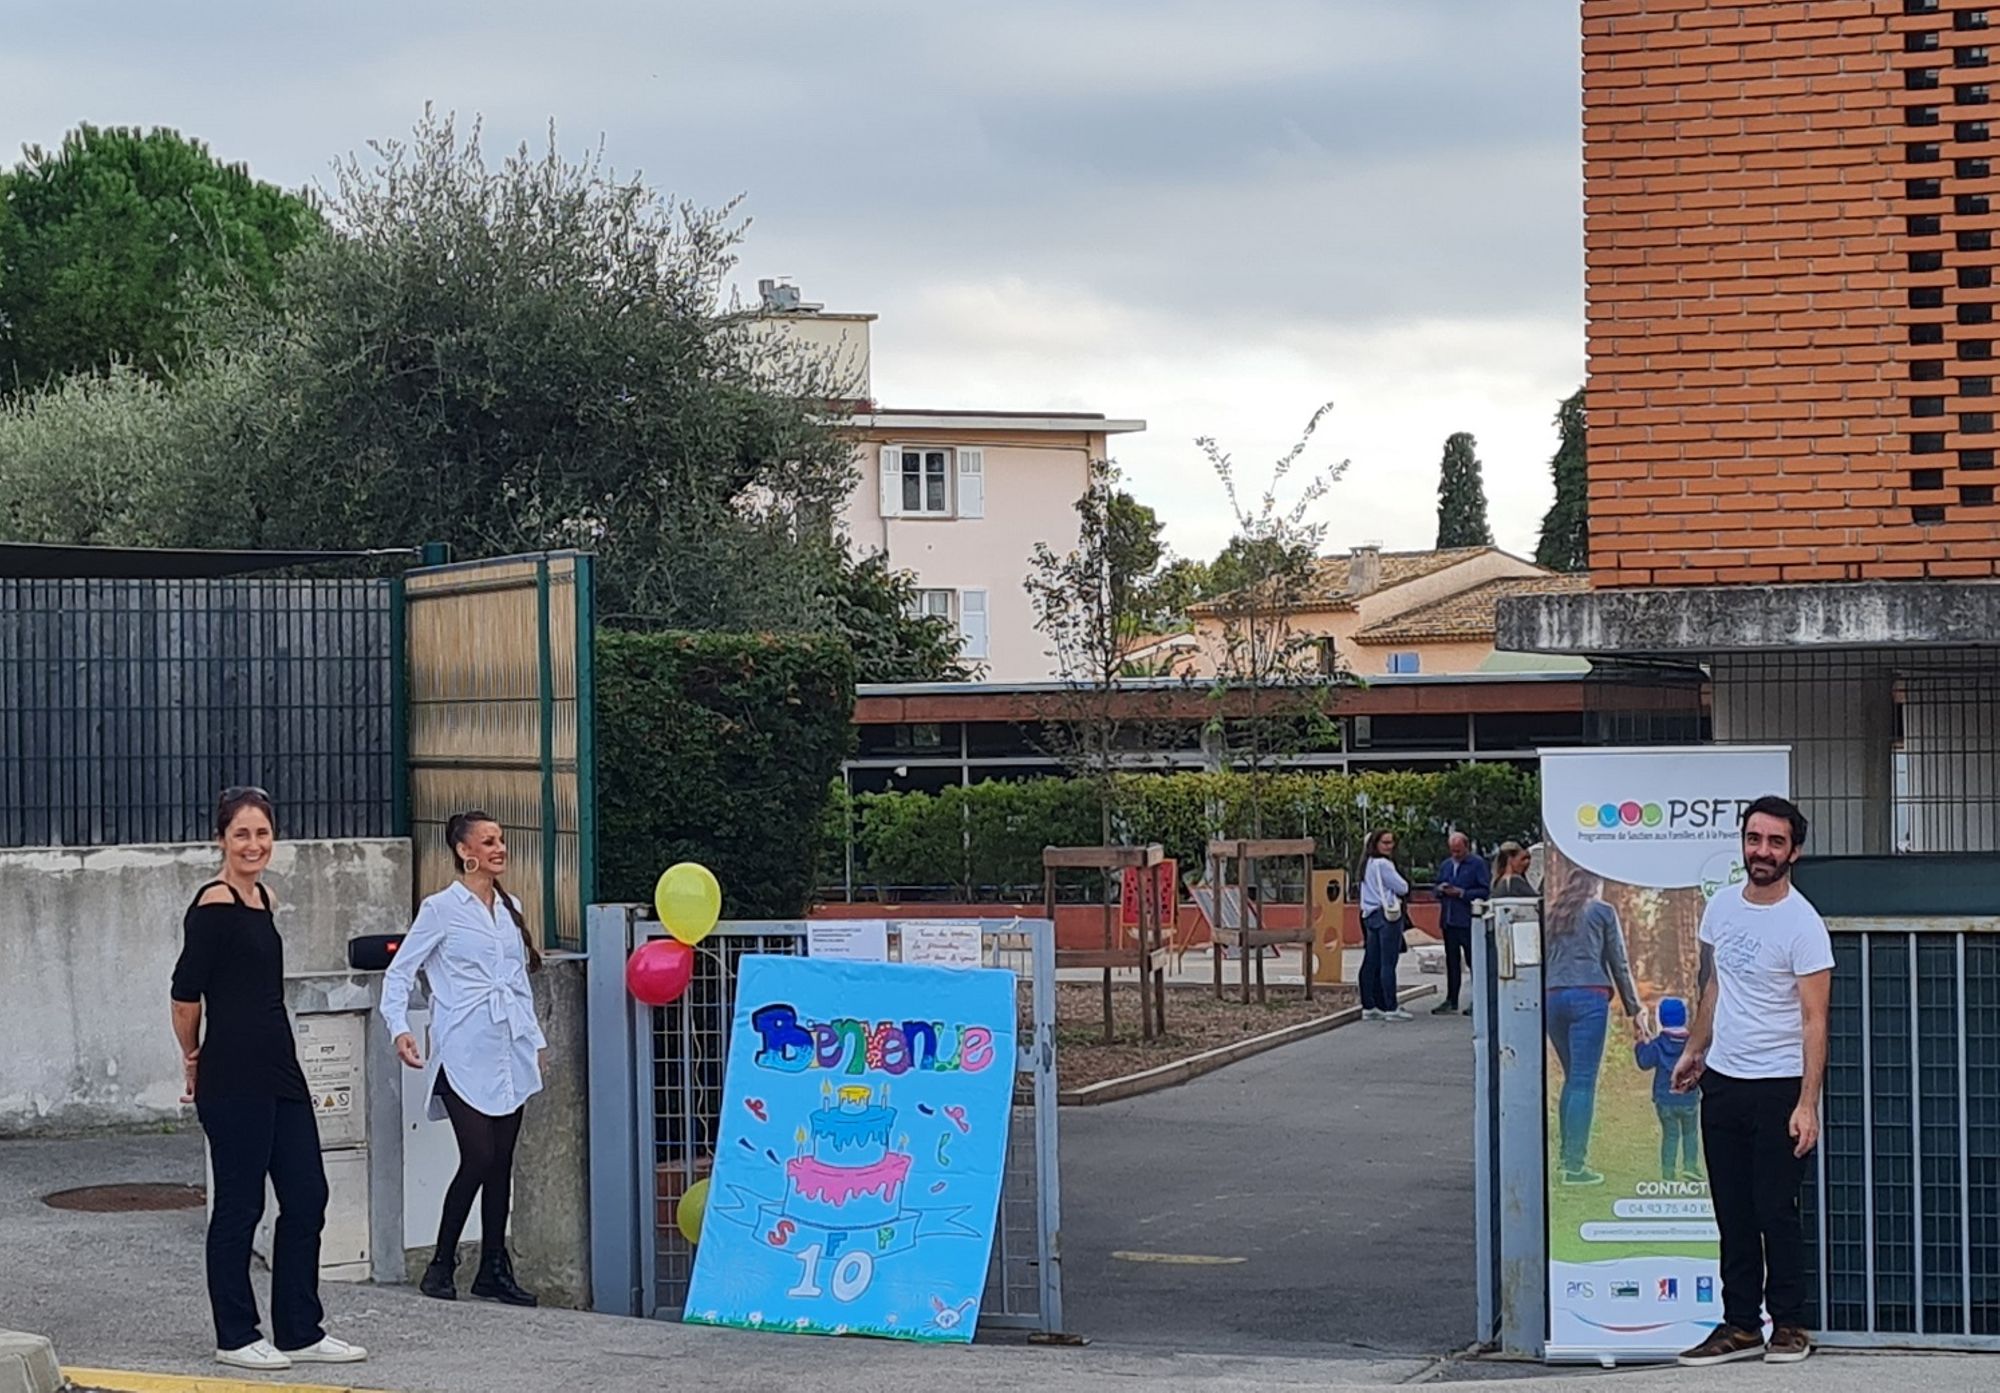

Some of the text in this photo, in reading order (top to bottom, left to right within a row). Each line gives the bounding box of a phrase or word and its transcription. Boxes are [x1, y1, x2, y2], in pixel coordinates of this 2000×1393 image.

[1578, 831, 1616, 843] Programme
[1618, 831, 1627, 841] de
[1669, 830, 1695, 840] Familles
[1698, 831, 1706, 840] et
[752, 1003, 994, 1076] Bienvenue
[1629, 1203, 1644, 1214] 04
[1646, 1203, 1663, 1214] 93
[1682, 1203, 1698, 1214] 40
[787, 1243, 875, 1304] 10
